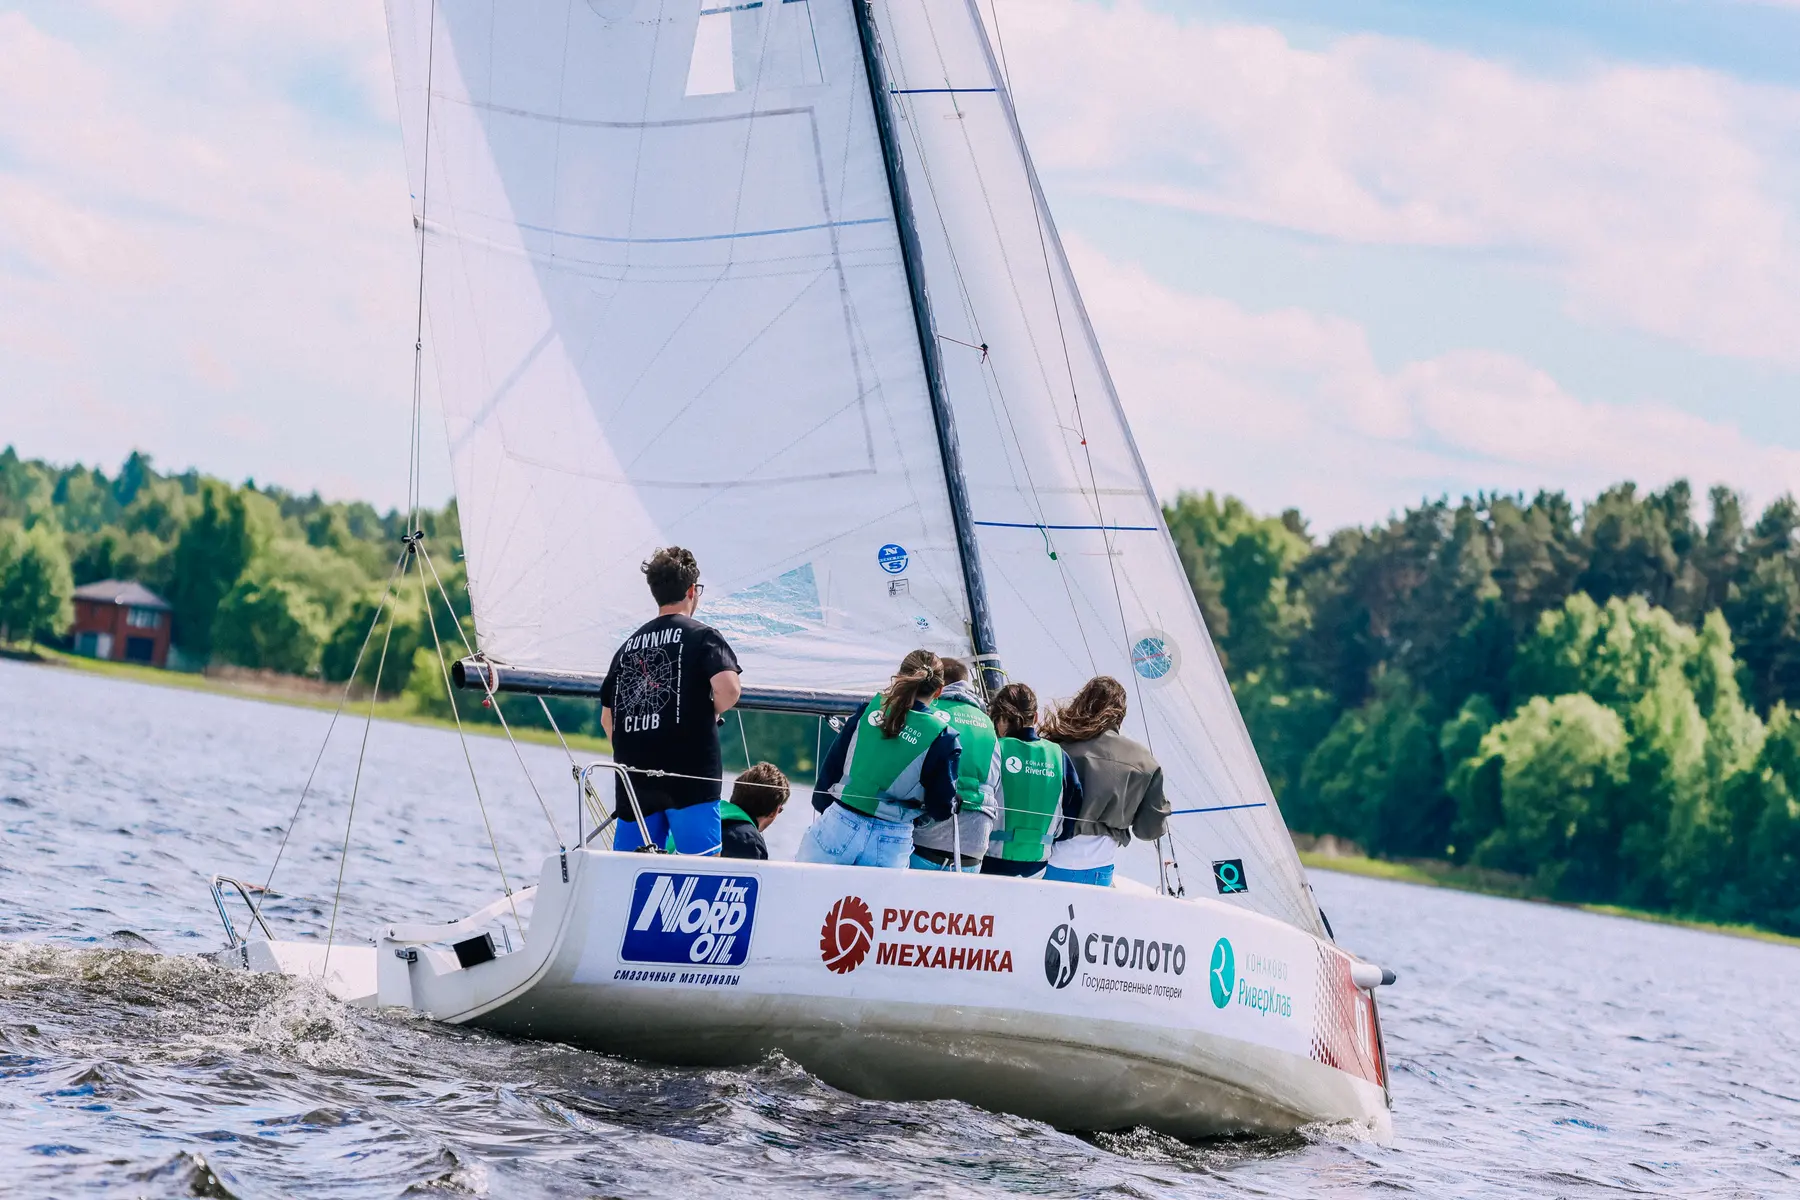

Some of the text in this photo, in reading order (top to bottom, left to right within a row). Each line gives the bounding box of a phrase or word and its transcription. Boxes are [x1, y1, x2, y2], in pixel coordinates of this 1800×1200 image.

[625, 627, 683, 653] RUNNING
[624, 713, 660, 733] CLUB
[954, 716, 988, 729] RiverClub
[898, 730, 918, 745] rClub
[1025, 766, 1055, 778] RiverClub
[881, 908, 995, 938] РУССКАЯ
[689, 932, 736, 964] OIL
[876, 942, 1013, 973] МЕХАНИКА
[1084, 932, 1186, 976] СТОЛОТО
[613, 969, 740, 986] смазочные материалы
[1245, 953, 1288, 981] КОНАКОВО
[1081, 972, 1182, 1000] Государственные лотереи
[1238, 977, 1292, 1018] РиверКлаб
